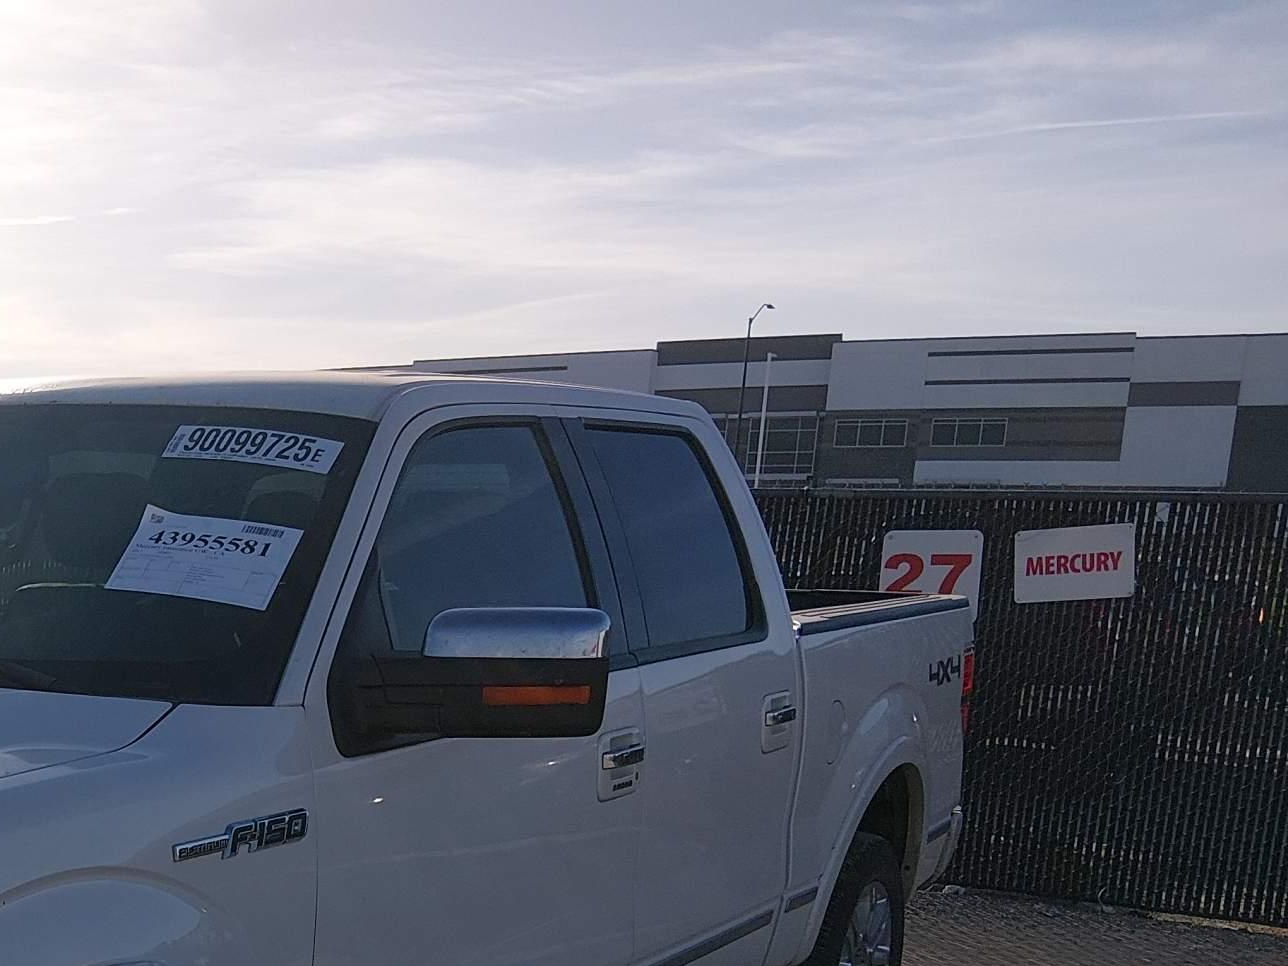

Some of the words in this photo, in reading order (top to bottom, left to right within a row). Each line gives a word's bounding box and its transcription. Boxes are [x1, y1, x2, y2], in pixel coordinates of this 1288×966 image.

[149, 530, 272, 557] 43955581
[884, 553, 972, 594] 27
[1025, 551, 1123, 576] MERCURY
